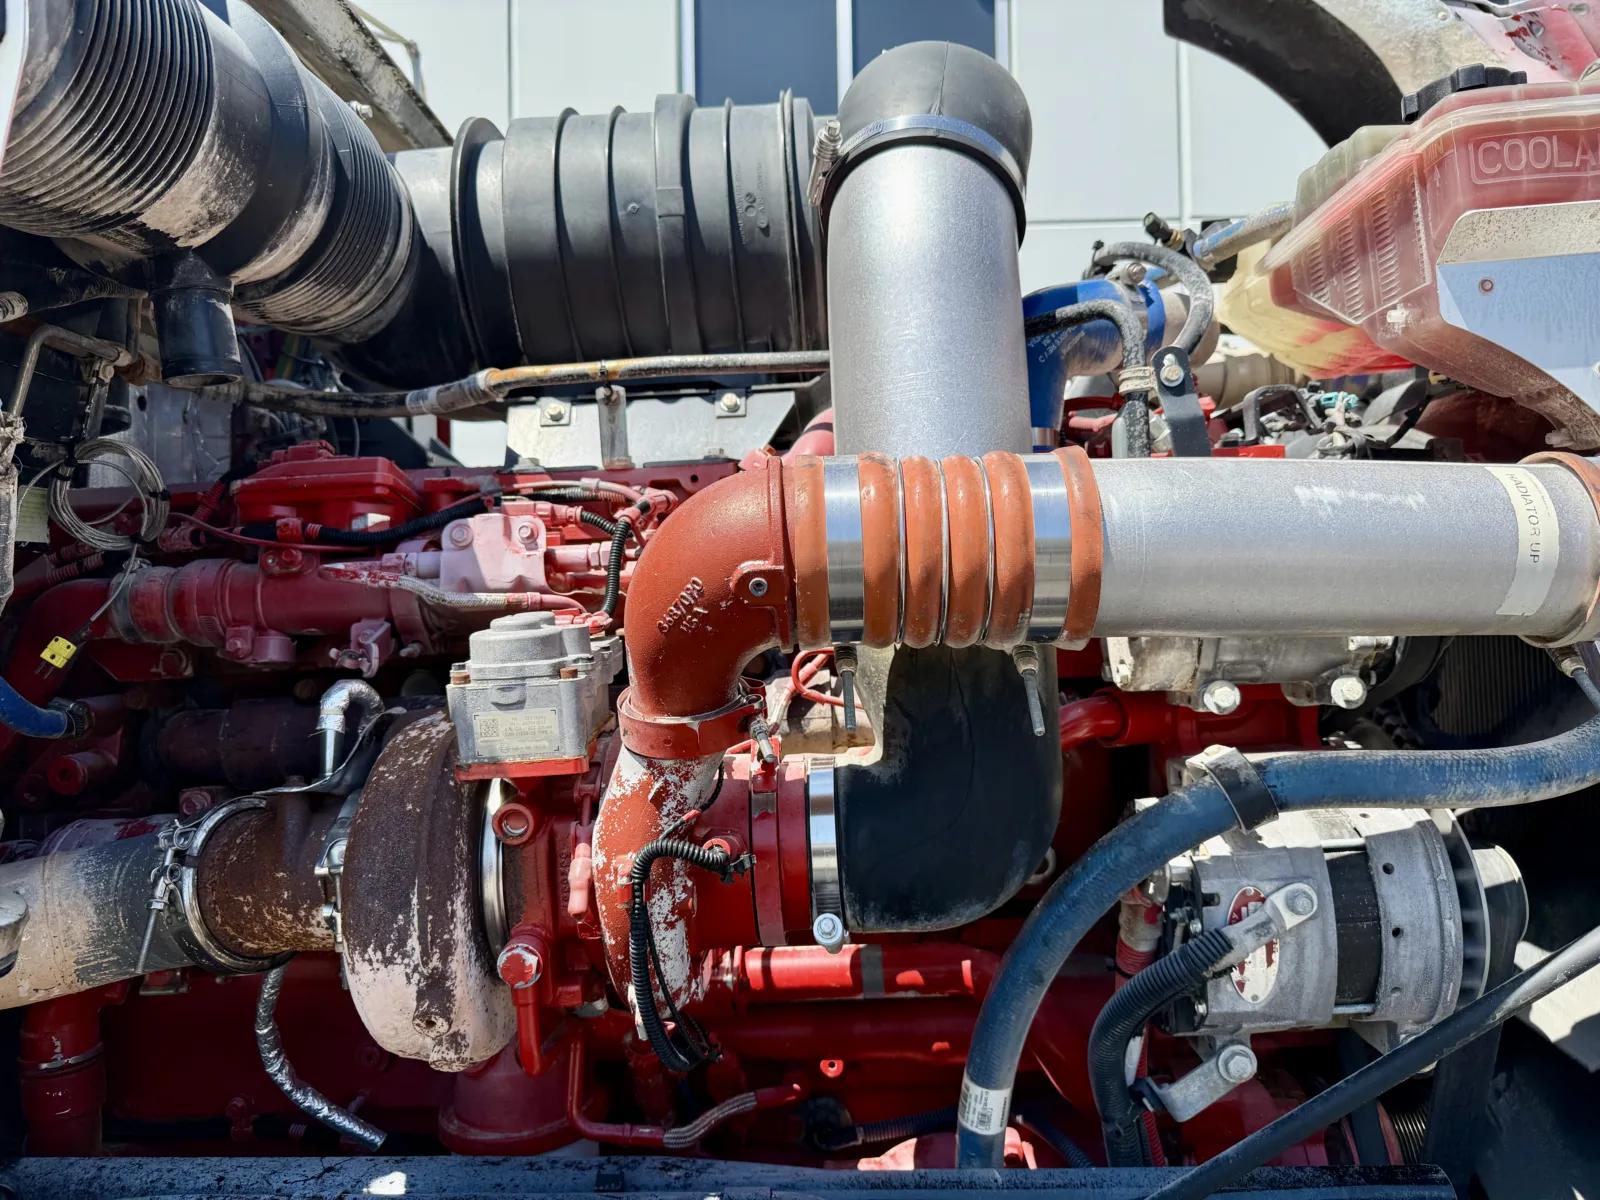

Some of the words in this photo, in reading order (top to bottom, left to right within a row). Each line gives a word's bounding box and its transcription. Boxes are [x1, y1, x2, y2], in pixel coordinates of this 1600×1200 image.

[1478, 133, 1600, 174] COOLA
[1506, 473, 1541, 536] RADIATOR
[1529, 542, 1541, 563] UP
